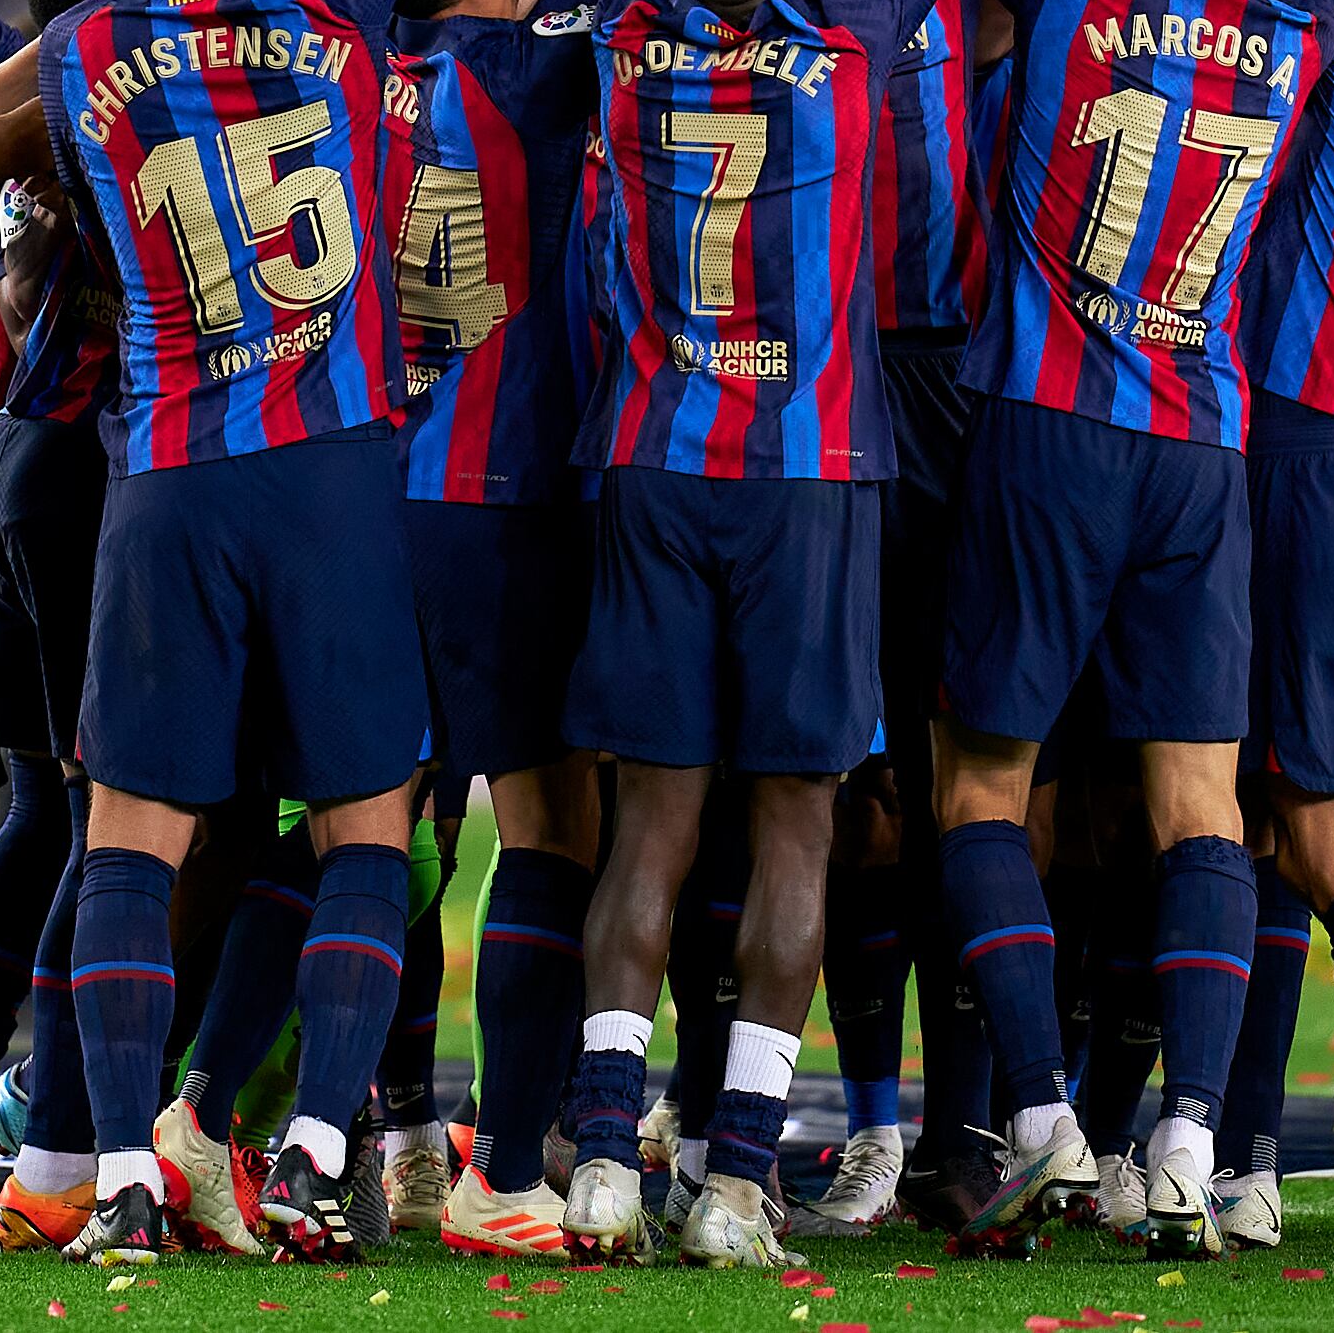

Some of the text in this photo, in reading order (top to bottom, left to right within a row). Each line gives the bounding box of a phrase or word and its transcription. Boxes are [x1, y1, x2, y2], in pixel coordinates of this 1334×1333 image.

[78, 26, 353, 145] CHRISTENSEN
[1083, 13, 1296, 106] MARCOS A.
[383, 73, 420, 124] RIC
[129, 99, 358, 335] 15
[660, 111, 768, 317] 7
[1070, 87, 1281, 311] 17
[262, 325, 333, 363] ACNUR
[706, 358, 788, 376] ACNUR
[709, 340, 788, 359] UNHCR
[1130, 321, 1207, 347] ACNUR
